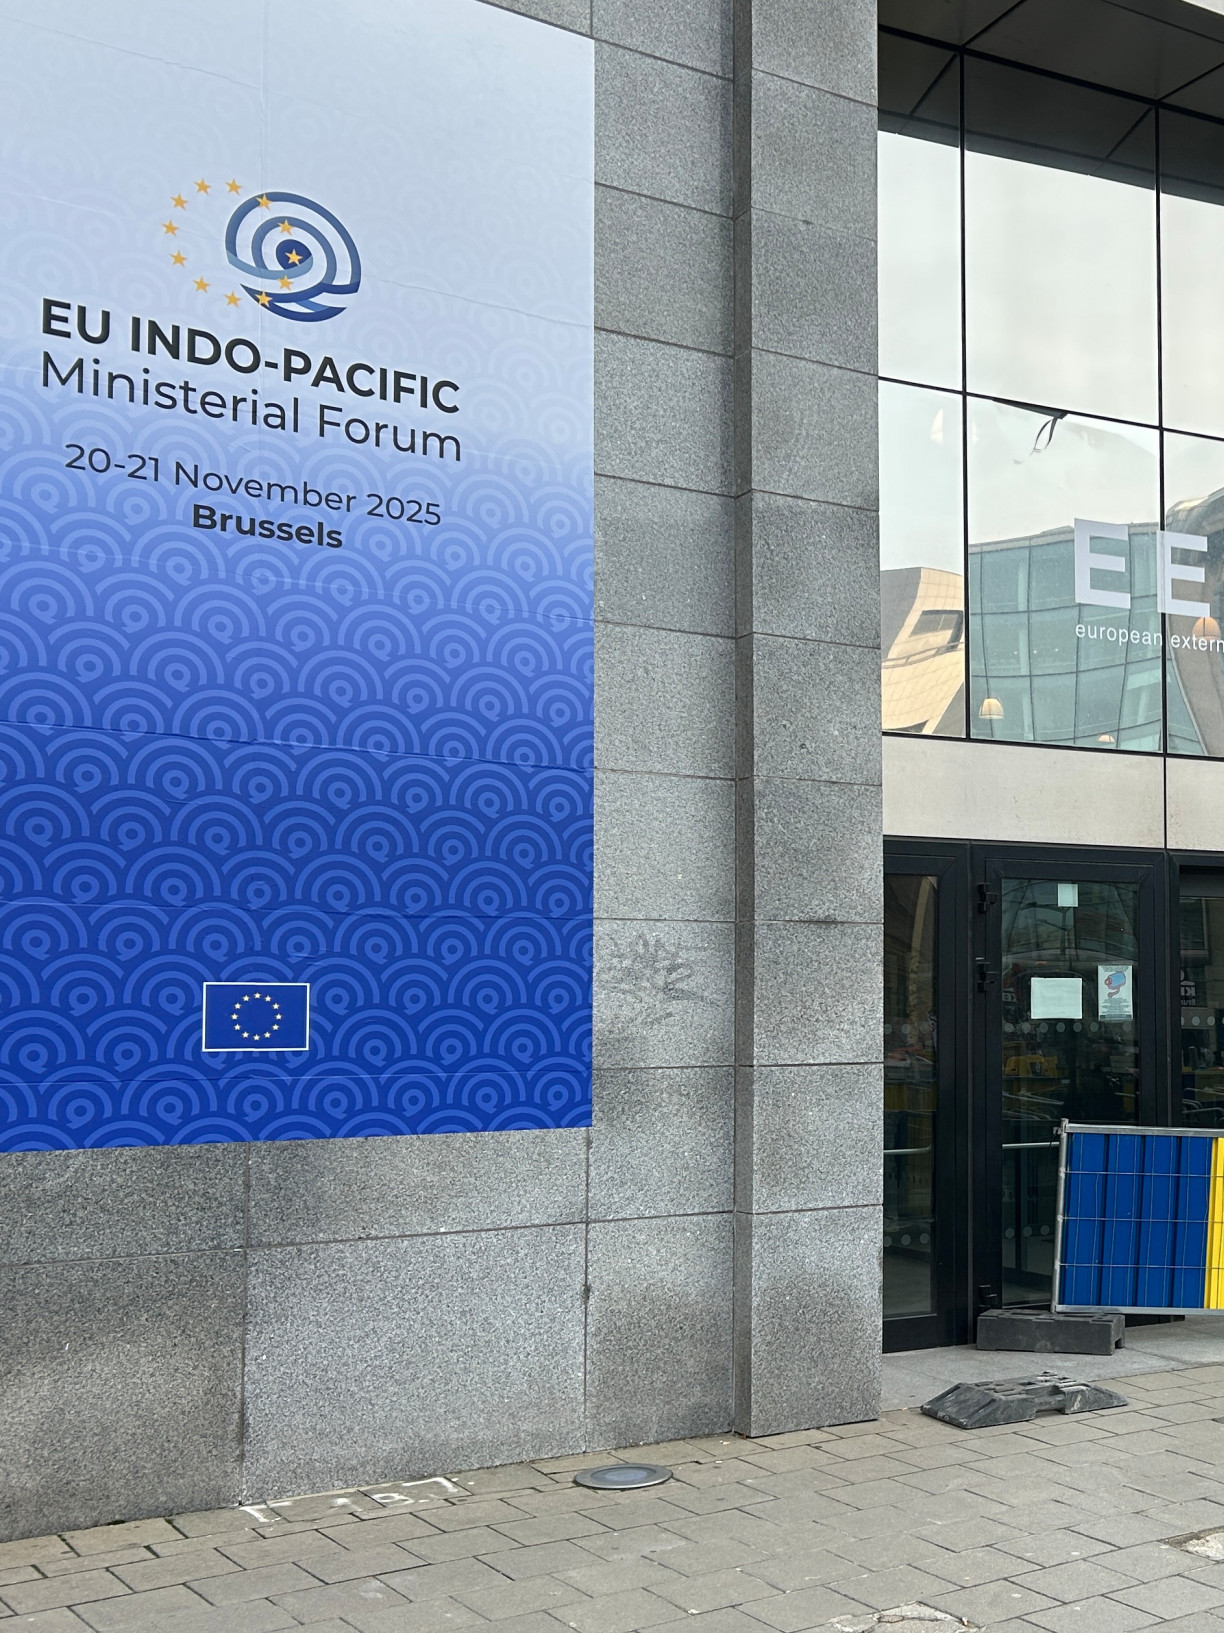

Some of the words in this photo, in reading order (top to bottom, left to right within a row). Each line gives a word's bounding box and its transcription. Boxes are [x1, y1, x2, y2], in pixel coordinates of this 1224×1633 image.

[42, 298, 111, 344] EU
[131, 315, 460, 414] INDO-PACIFIC
[42, 350, 300, 433] Ministerial
[319, 406, 463, 462] Forum
[64, 444, 161, 483] 20-21
[175, 463, 357, 513] November
[366, 493, 442, 527] 2025
[193, 504, 343, 549] Brussels
[1075, 622, 1163, 647] european
